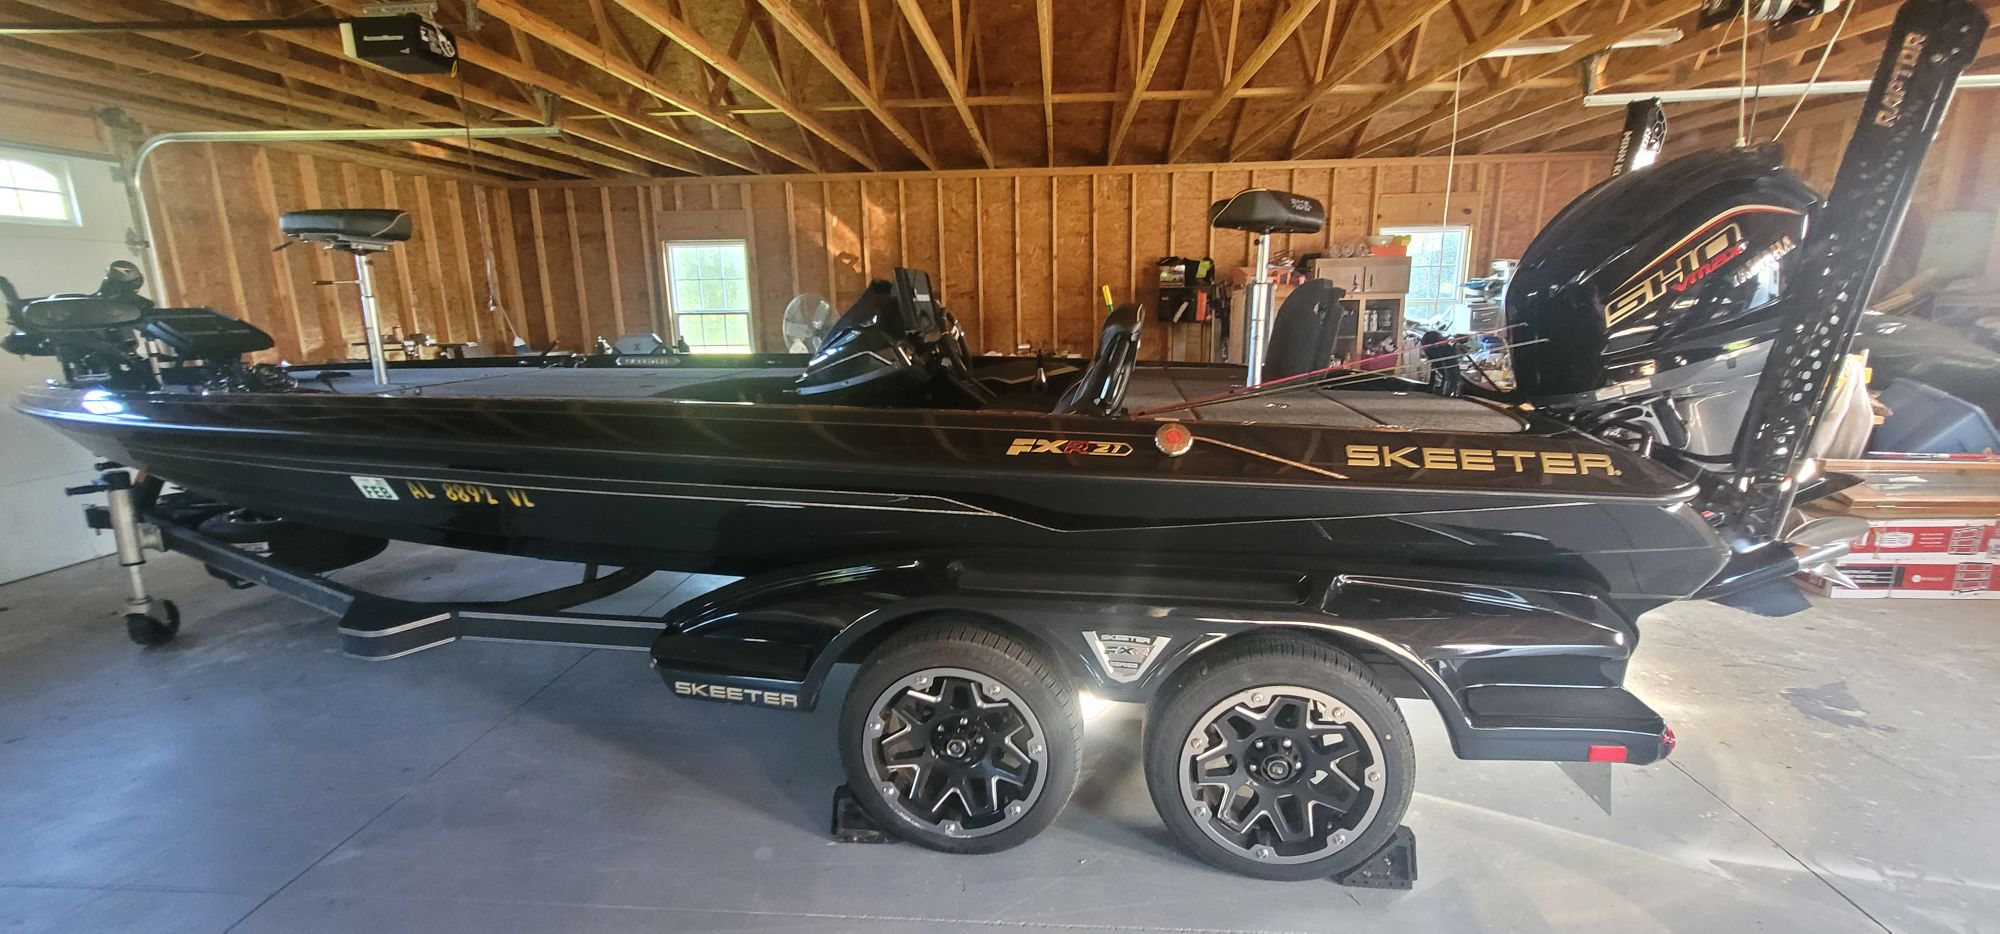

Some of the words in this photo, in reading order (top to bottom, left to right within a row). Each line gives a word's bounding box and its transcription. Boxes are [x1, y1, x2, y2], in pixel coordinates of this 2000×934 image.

[1873, 31, 1928, 128] RAPTOR
[1615, 130, 1633, 163] MINN
[1604, 222, 1743, 329] SHO
[1729, 234, 1797, 289] YAHA
[361, 484, 393, 499] FEB
[405, 480, 436, 500] AL
[442, 481, 499, 505] 8892
[505, 488, 536, 507] VL
[674, 680, 799, 708] SKEETER
